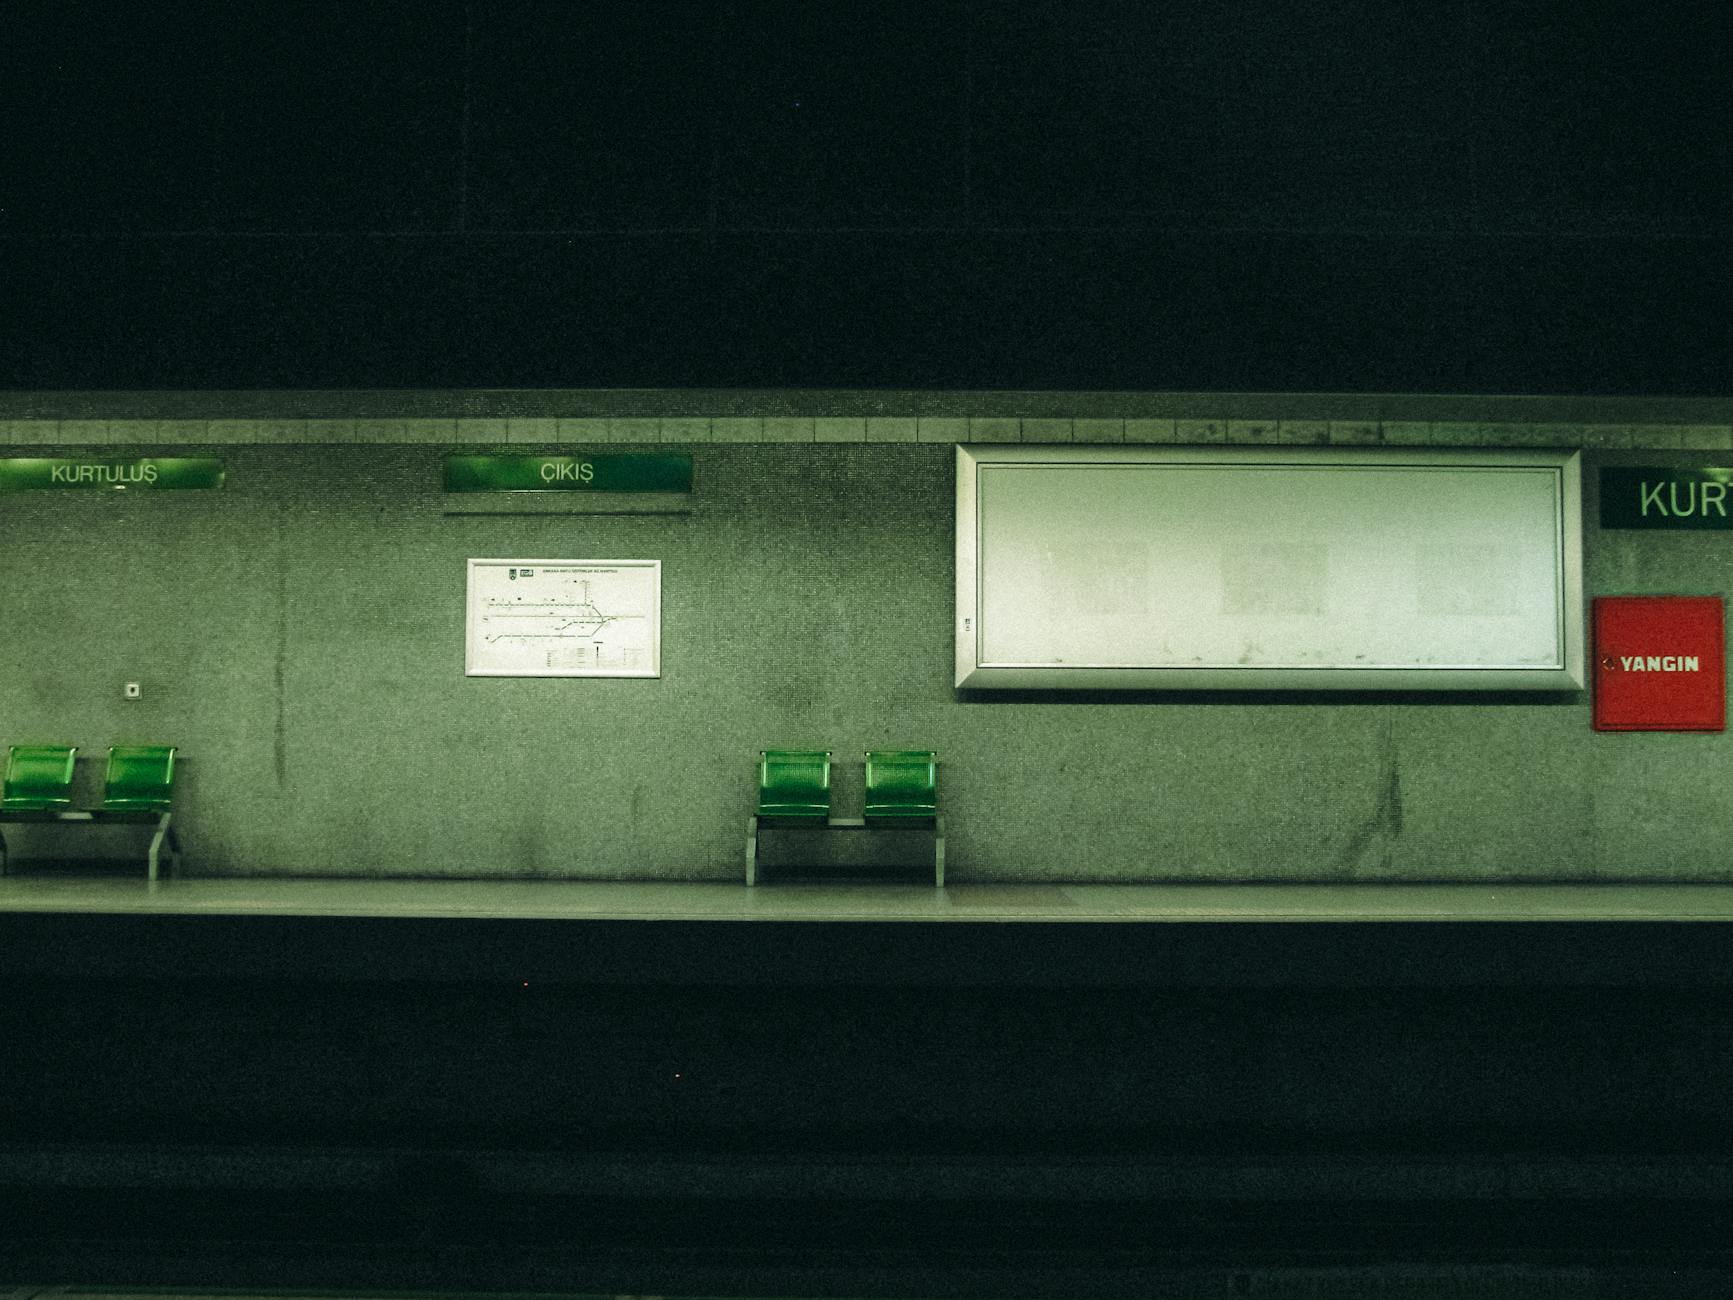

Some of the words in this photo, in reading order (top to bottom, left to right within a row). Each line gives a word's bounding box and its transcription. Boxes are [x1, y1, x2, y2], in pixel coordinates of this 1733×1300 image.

[51, 464, 158, 485] KURTULUŞ
[541, 463, 594, 484] ÇIKIŞ
[1641, 481, 1733, 517] KUR
[1620, 656, 1699, 672] YANGIN
